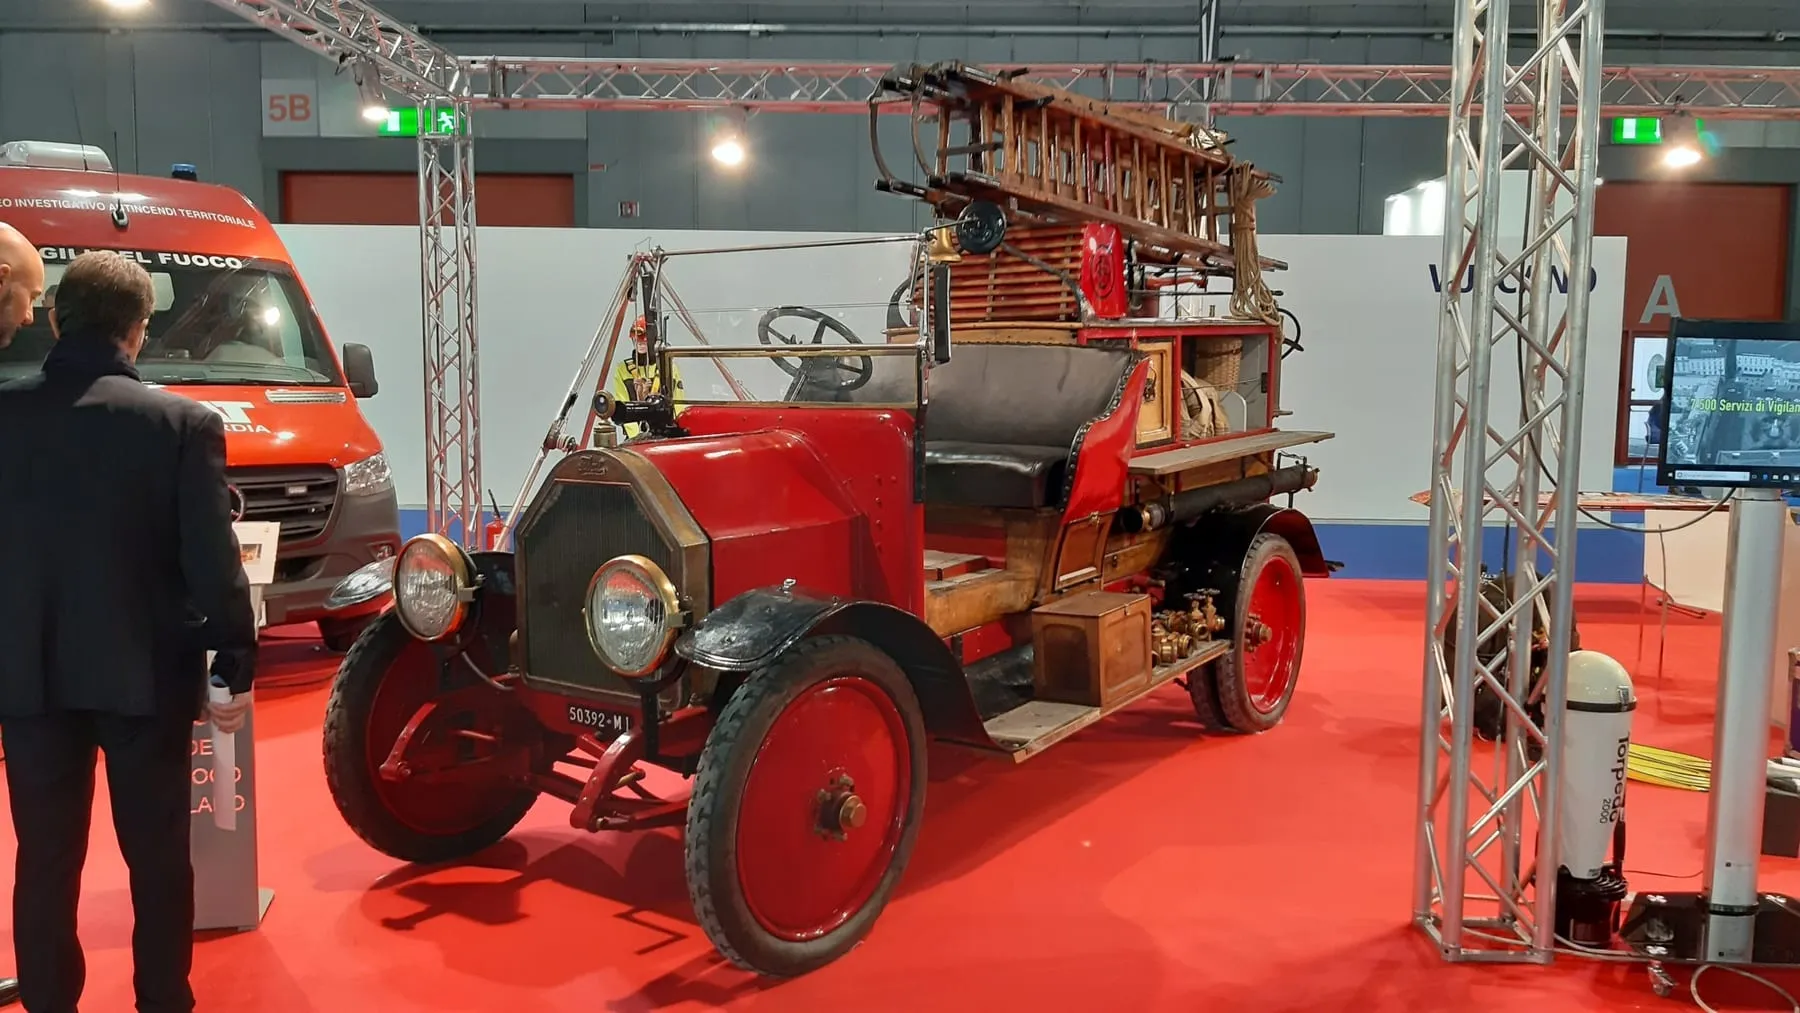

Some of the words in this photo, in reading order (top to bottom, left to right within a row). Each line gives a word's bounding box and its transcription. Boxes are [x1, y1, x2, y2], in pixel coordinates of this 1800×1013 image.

[268, 94, 312, 122] 5B
[15, 198, 106, 212] INVESTIGATIVO
[179, 208, 256, 229] TERRITORIALE
[158, 252, 243, 269] FUOCO
[1639, 274, 1682, 323] A
[1720, 399, 1753, 412] Servizi
[1756, 401, 1765, 412] di
[1600, 798, 1611, 823] 2000
